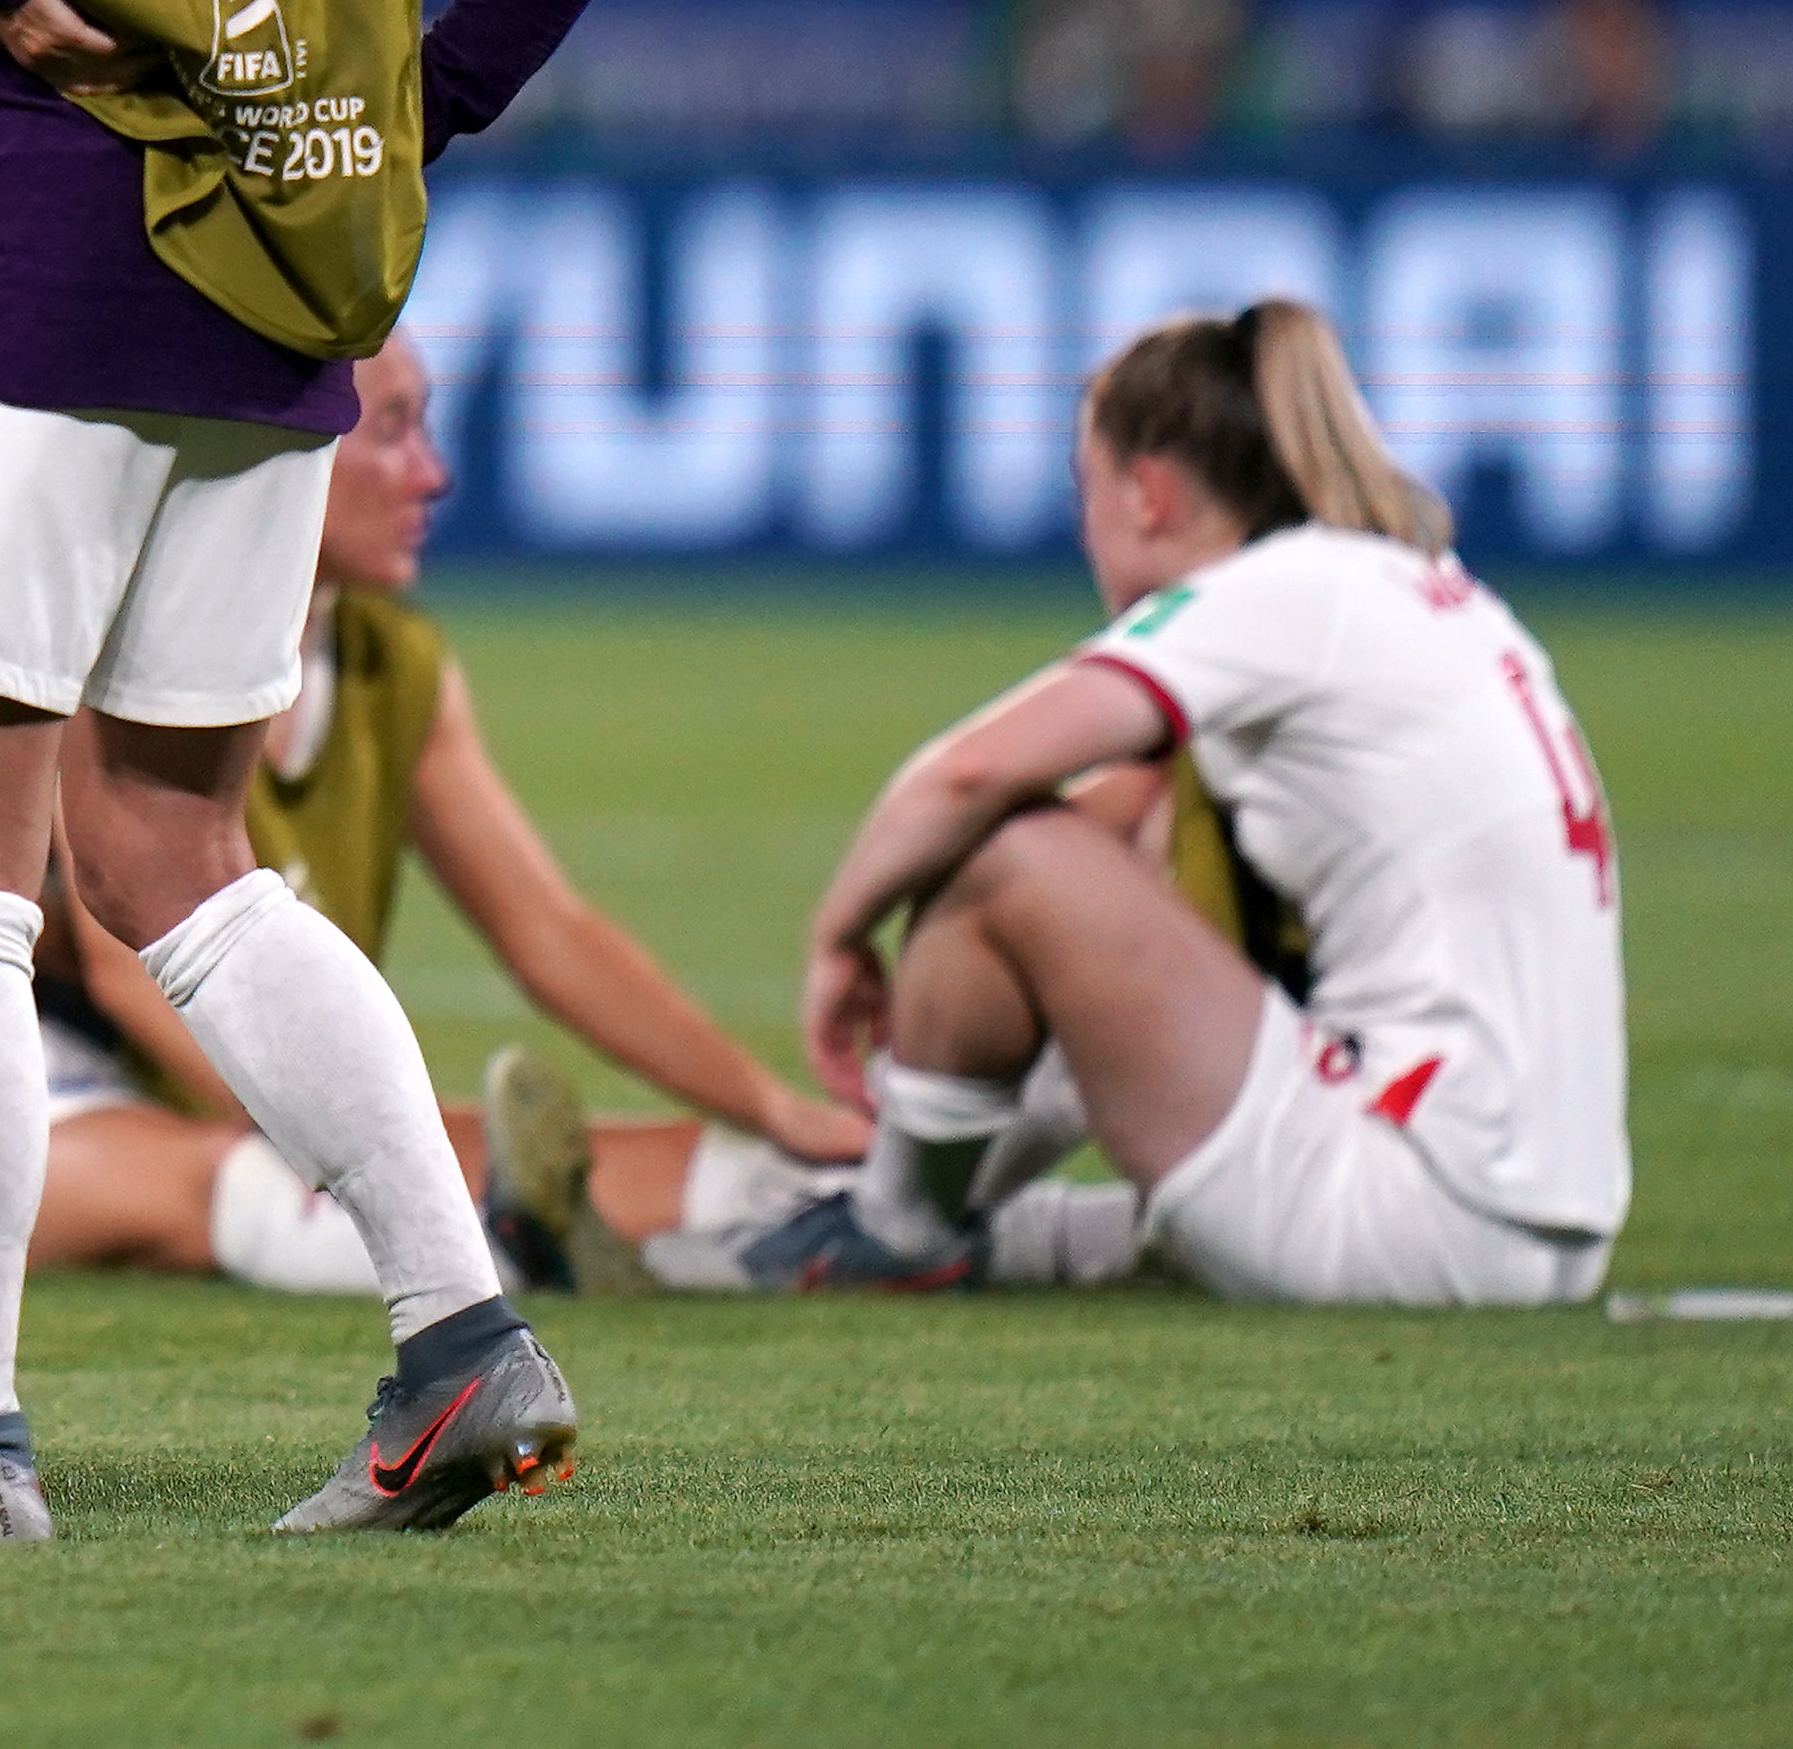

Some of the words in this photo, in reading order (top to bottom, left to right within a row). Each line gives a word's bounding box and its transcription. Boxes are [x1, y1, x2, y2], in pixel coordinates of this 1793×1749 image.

[216, 50, 283, 82] FIFA
[313, 96, 366, 123] CUP
[282, 124, 385, 181] 2019
